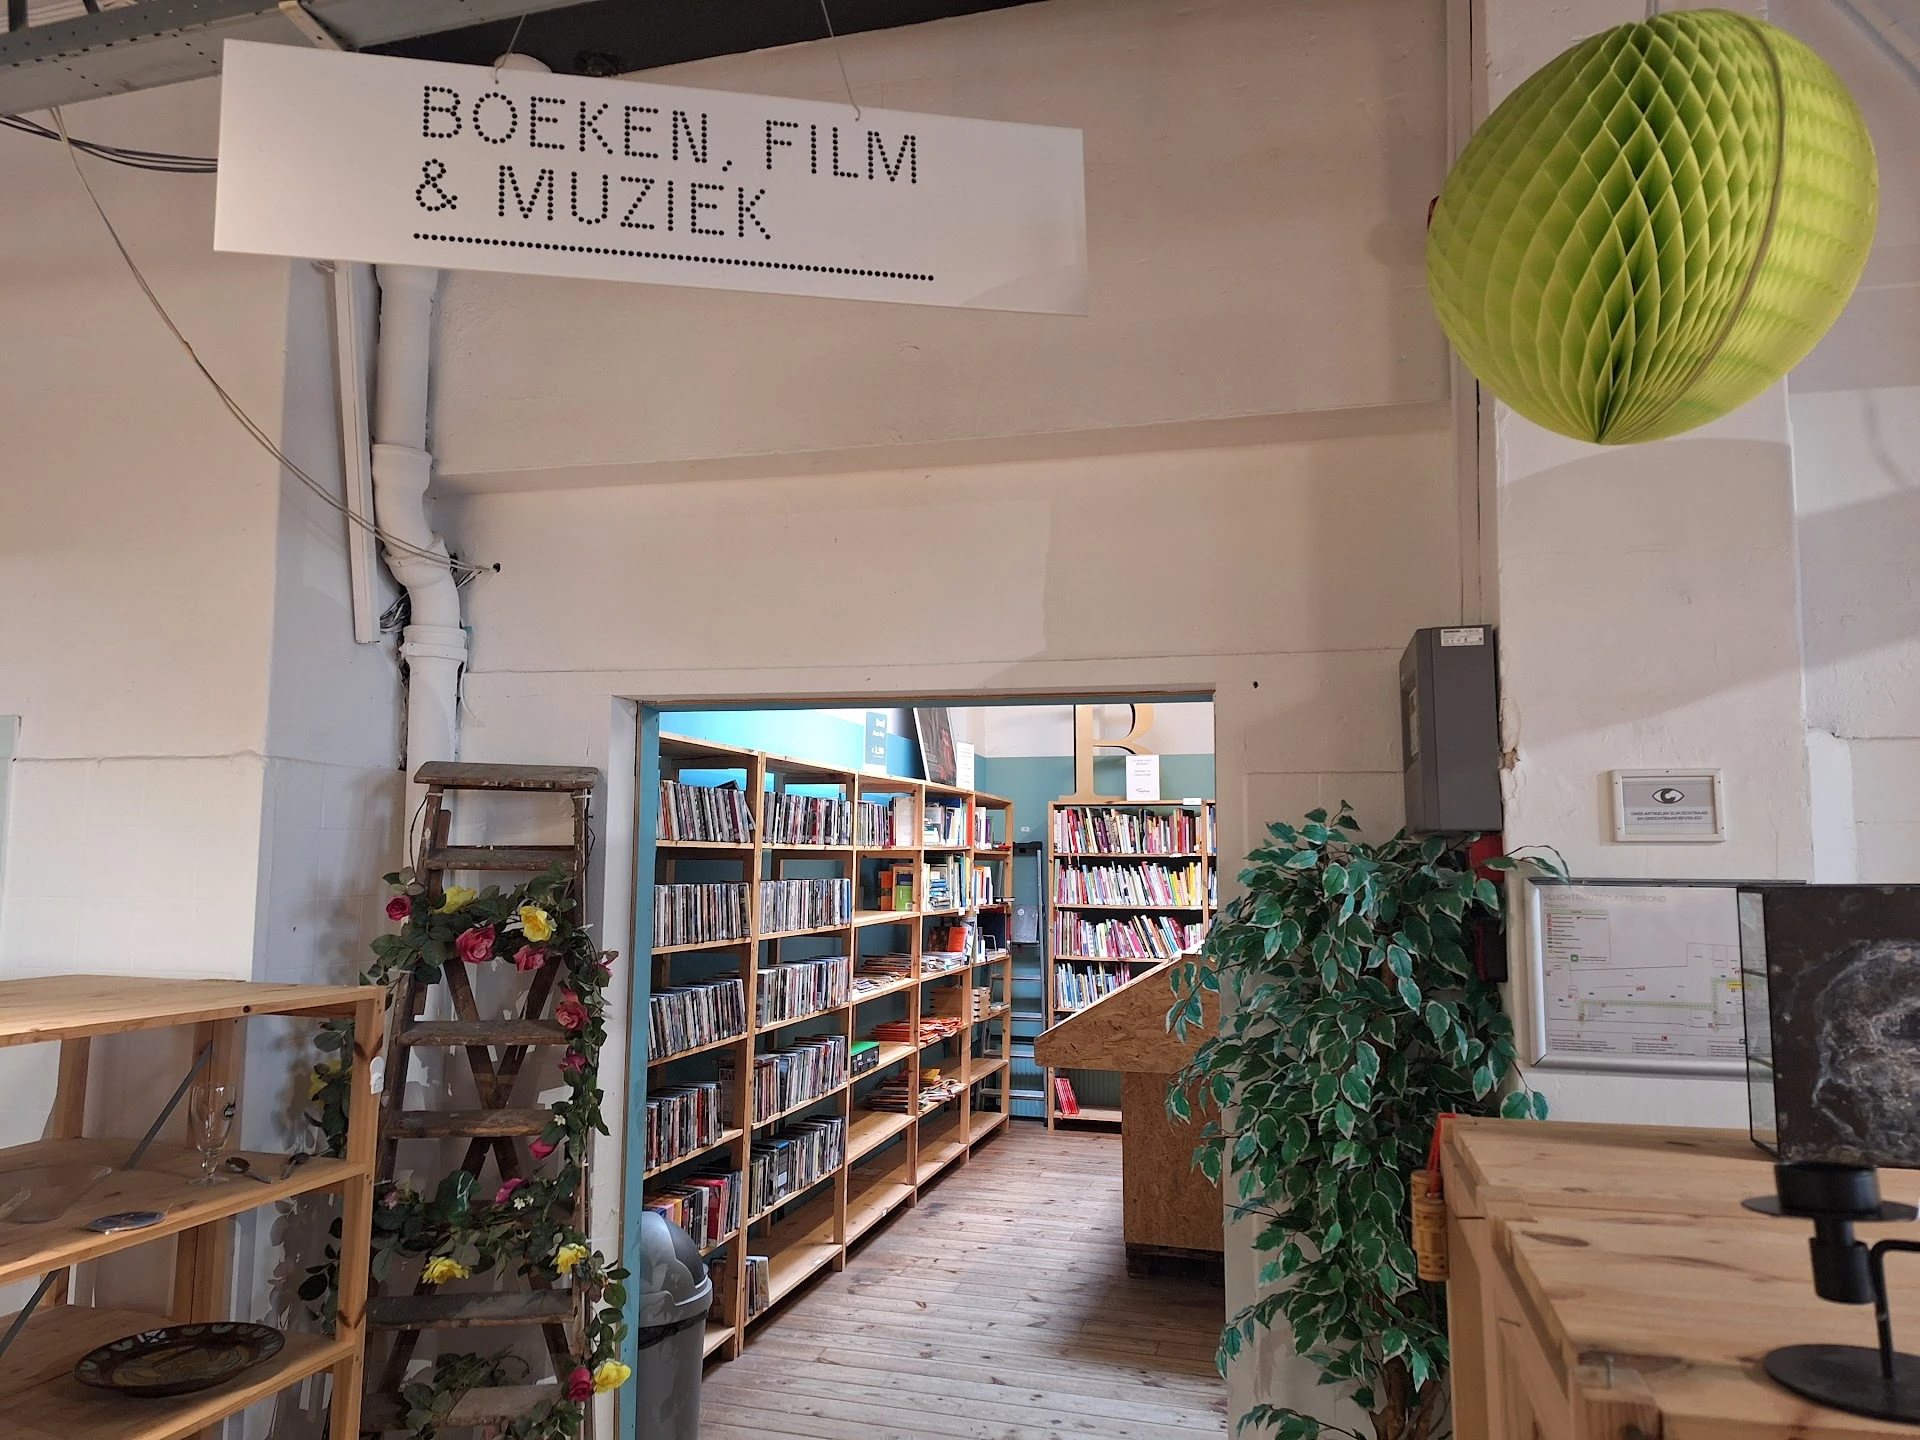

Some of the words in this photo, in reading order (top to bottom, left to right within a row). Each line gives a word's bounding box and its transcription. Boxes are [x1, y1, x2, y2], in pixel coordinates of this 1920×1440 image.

[422, 85, 733, 172] BOEKEN,
[766, 119, 918, 184] FILM
[415, 158, 458, 212] &
[498, 165, 771, 240] MUZIEK
